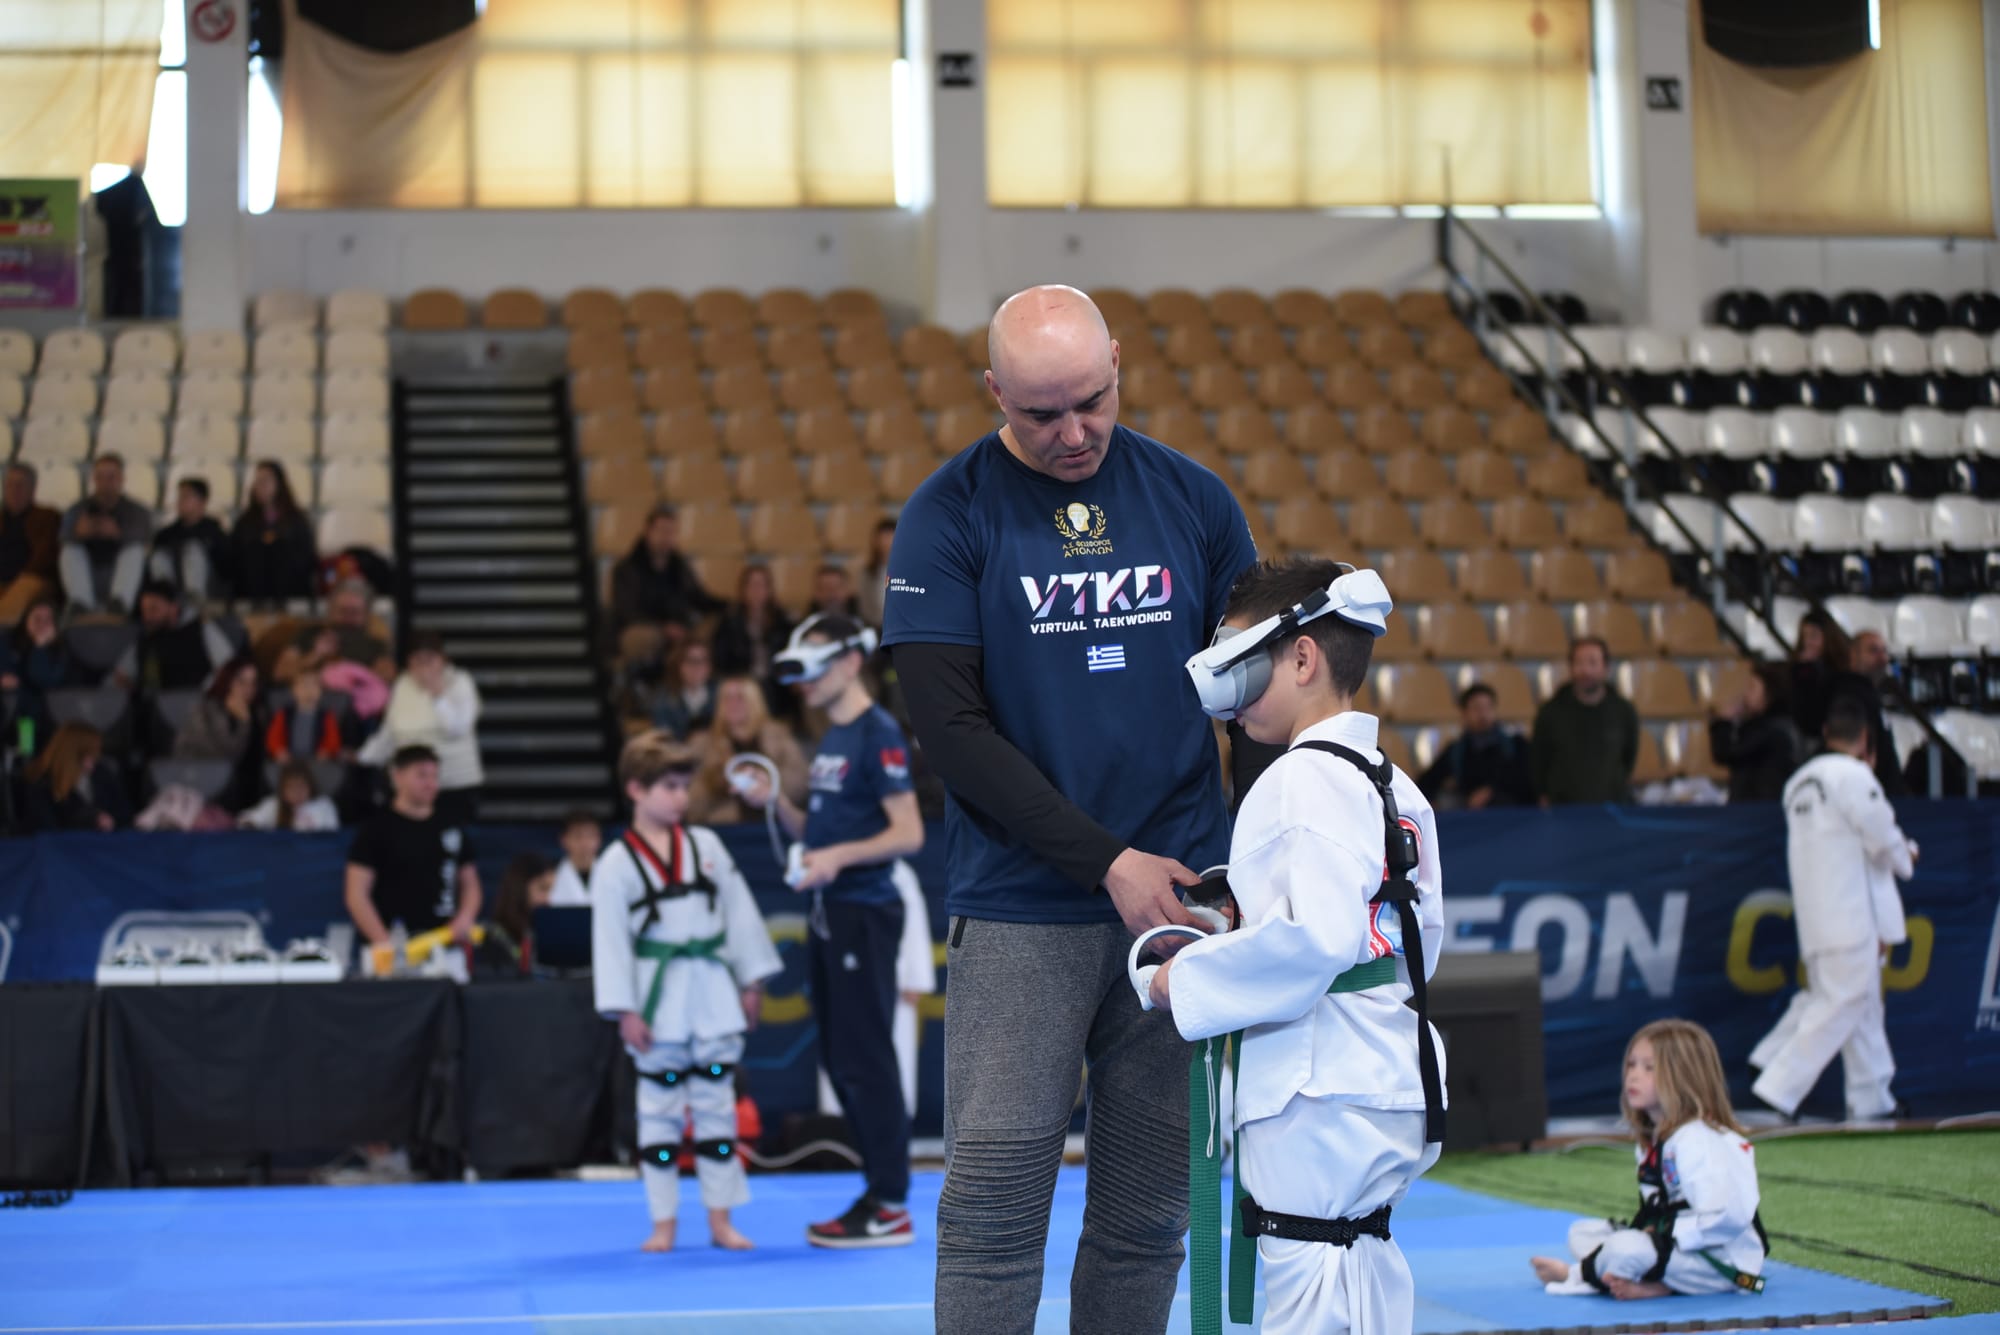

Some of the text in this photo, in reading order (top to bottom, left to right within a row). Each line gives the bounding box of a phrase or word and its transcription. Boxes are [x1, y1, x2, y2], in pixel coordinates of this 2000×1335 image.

[1064, 546, 1113, 558] ΑΠΟΛΛΩΝ
[890, 585, 926, 594] TAEKWONDO
[1020, 565, 1173, 620] VTKD
[1030, 610, 1172, 635] VIRTUAL TAEKWONDO
